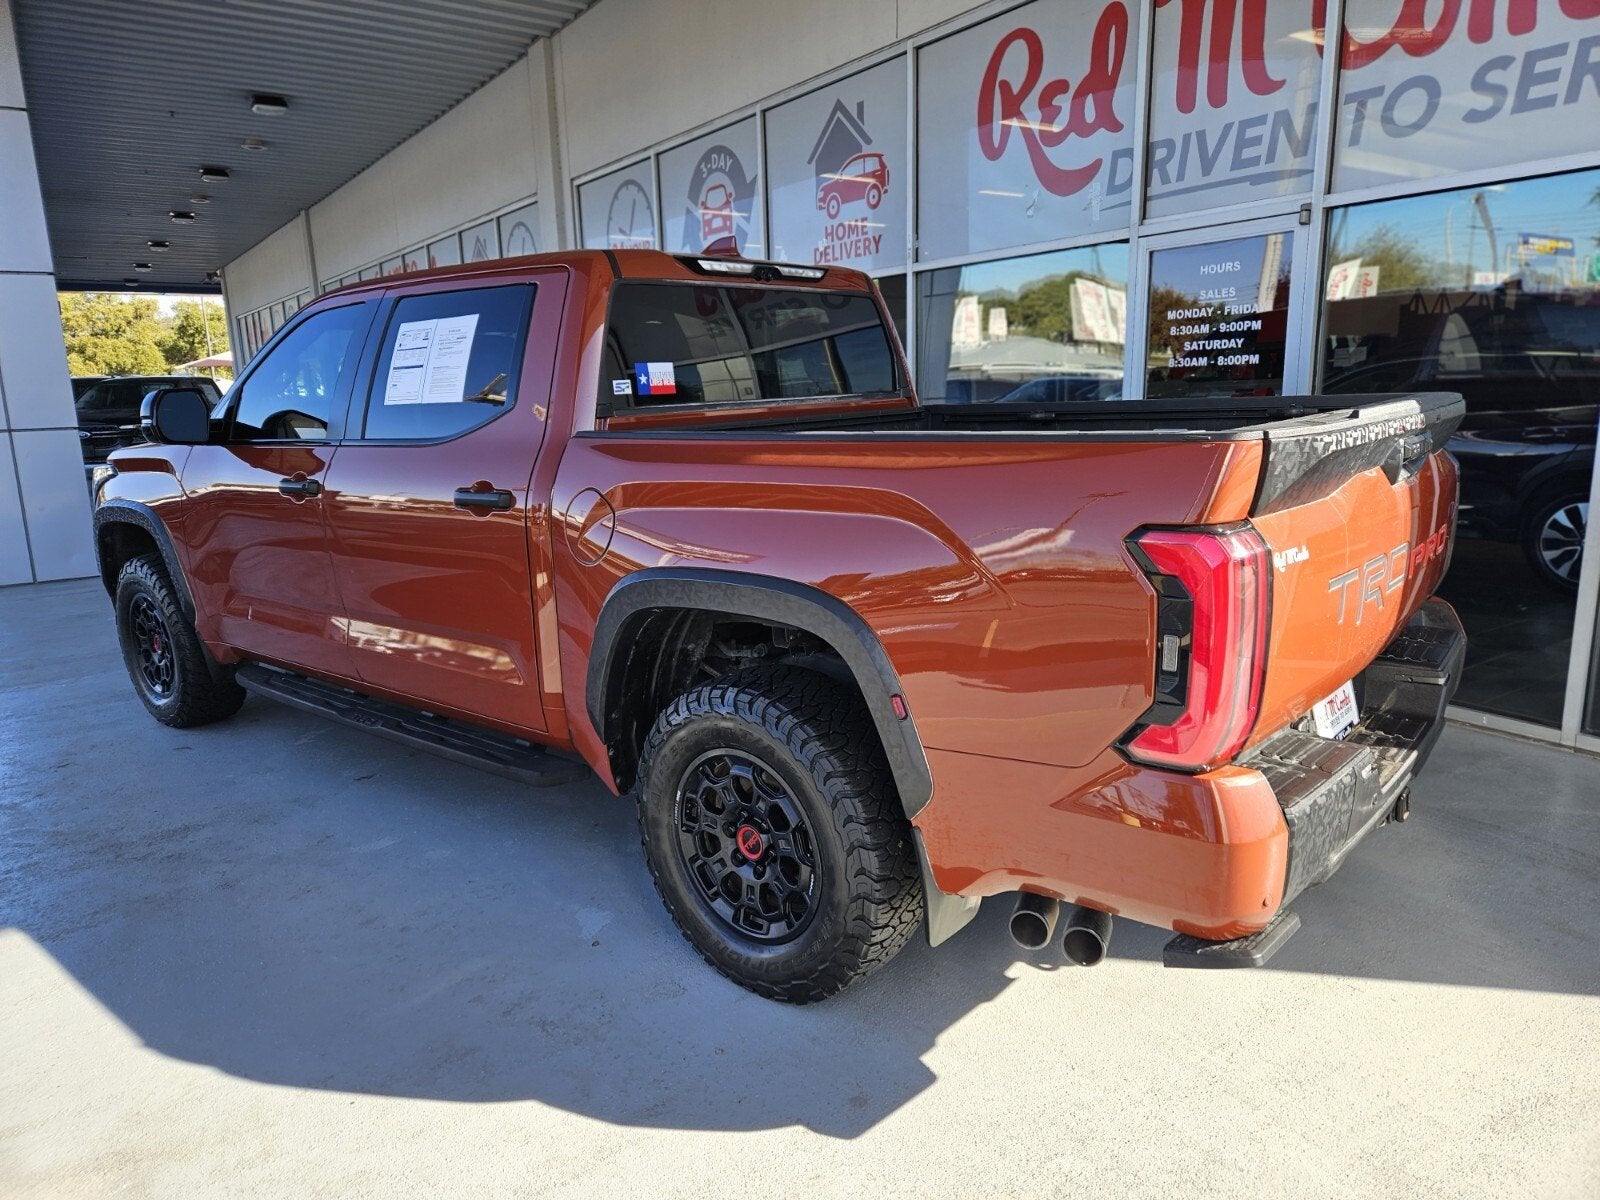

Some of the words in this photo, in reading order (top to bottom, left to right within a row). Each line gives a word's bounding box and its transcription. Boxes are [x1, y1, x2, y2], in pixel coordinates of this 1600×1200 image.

[978, 1, 1128, 196] Red
[1106, 102, 1318, 196] DRIVEN
[1344, 75, 1441, 147] TO
[700, 154, 733, 178] 3-DAY
[825, 217, 868, 242] HOME
[814, 234, 882, 265] DELIVERY
[1200, 261, 1241, 275] HOURS
[1200, 287, 1236, 300] SALES
[1167, 307, 1214, 320] MONDAY
[1170, 323, 1209, 336] 8:30AM
[1219, 320, 1262, 333] 9:00PM
[1184, 338, 1244, 351] SATURDAY
[1168, 356, 1208, 368] 8:30AM
[1217, 354, 1259, 366] 8:00PM
[1328, 542, 1409, 626] TRD
[1408, 523, 1447, 579] PRO
